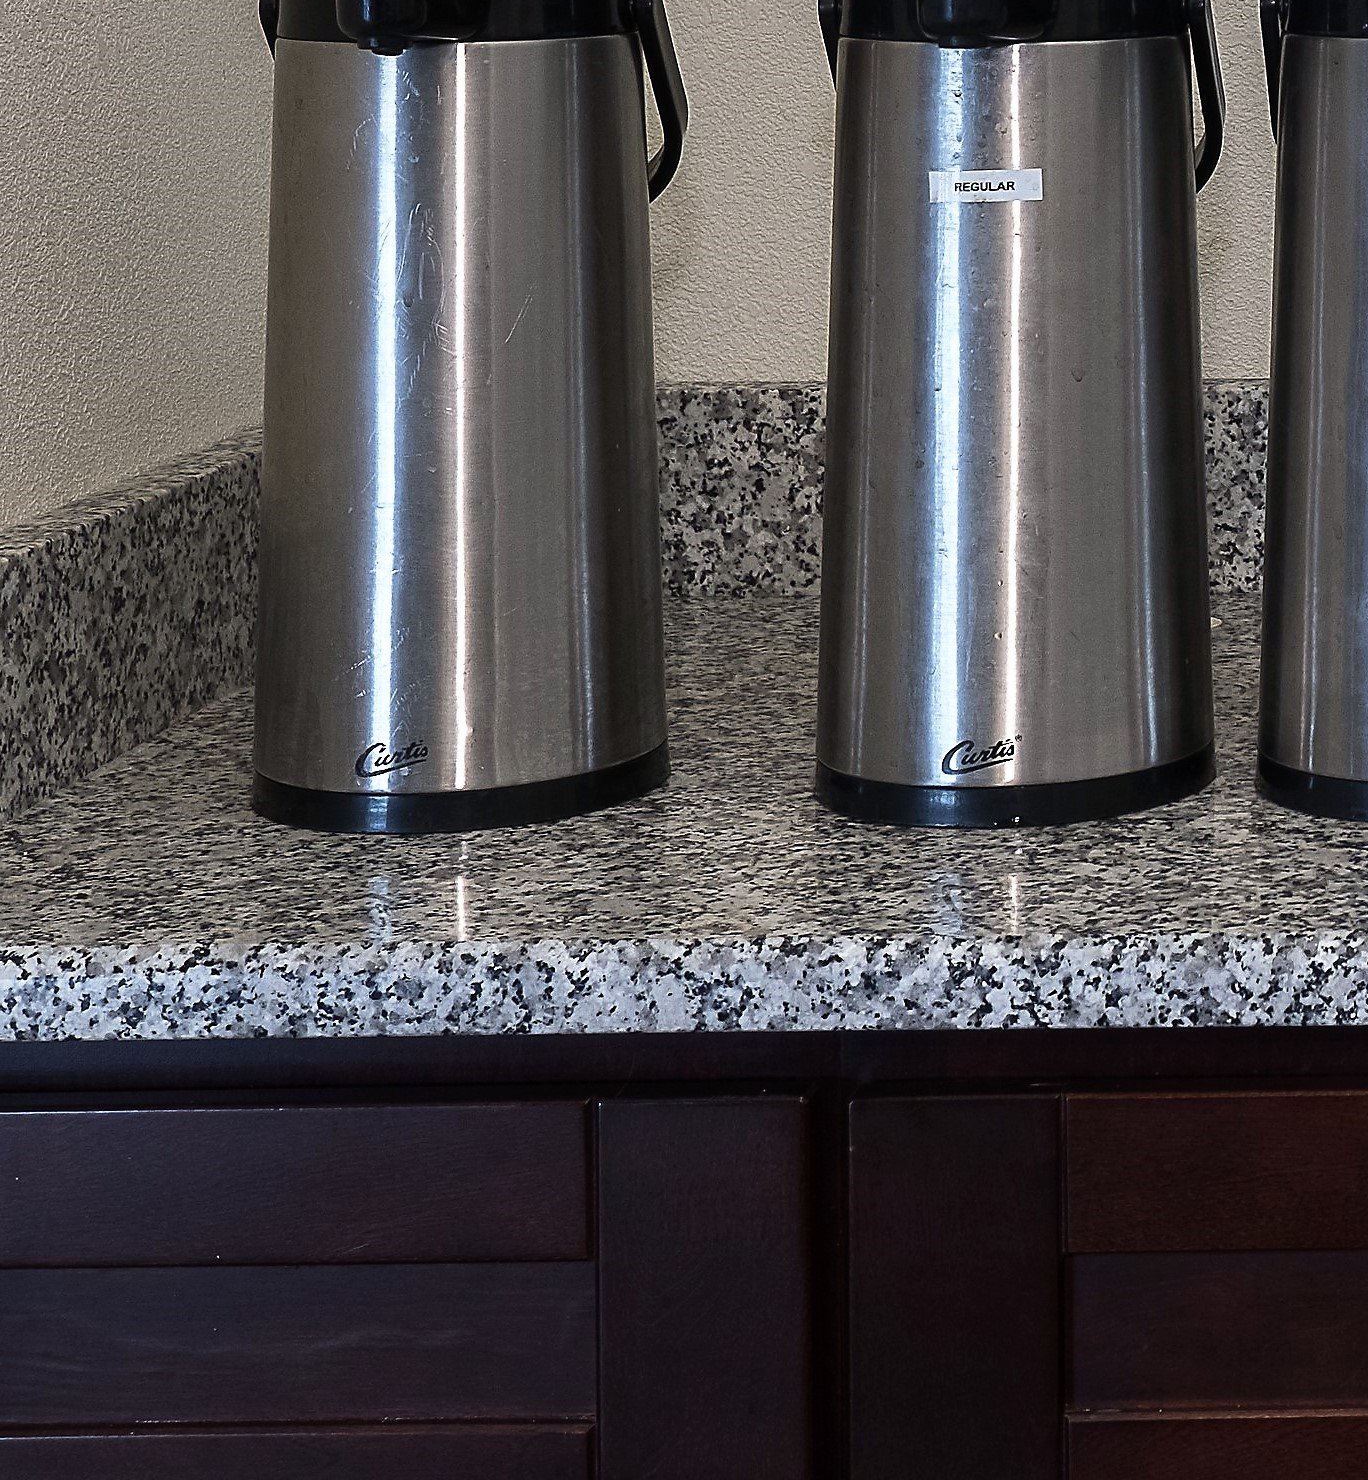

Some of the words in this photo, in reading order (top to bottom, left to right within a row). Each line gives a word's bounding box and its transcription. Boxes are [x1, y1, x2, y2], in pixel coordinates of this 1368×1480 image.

[954, 181, 1015, 192] REGULAR
[355, 740, 429, 778] Curtis
[942, 739, 1015, 775] Curtis
